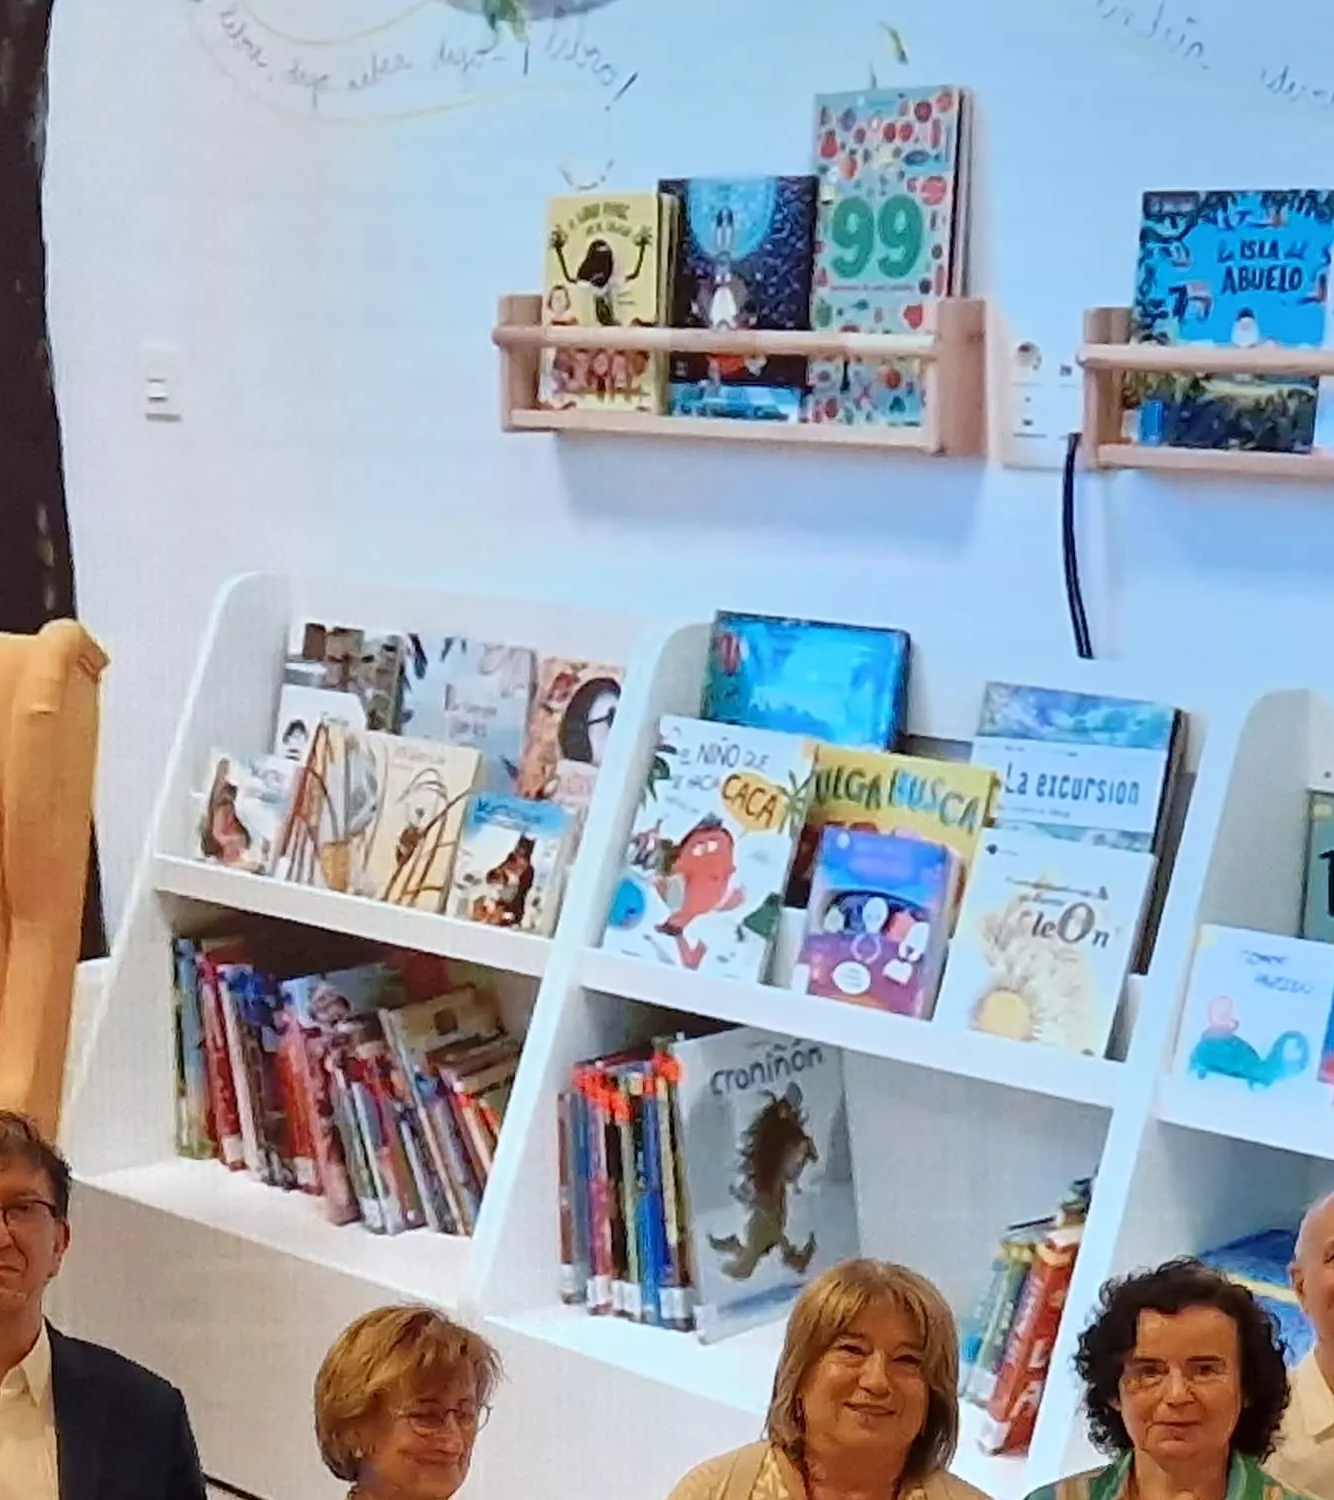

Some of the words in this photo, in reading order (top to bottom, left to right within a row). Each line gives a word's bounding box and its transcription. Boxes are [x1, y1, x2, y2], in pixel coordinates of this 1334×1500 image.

[831, 193, 924, 279] 99
[1239, 239, 1281, 260] ISLA
[1221, 264, 1304, 295] ABUELO
[1004, 762, 1029, 796] La
[722, 773, 779, 829] CACA
